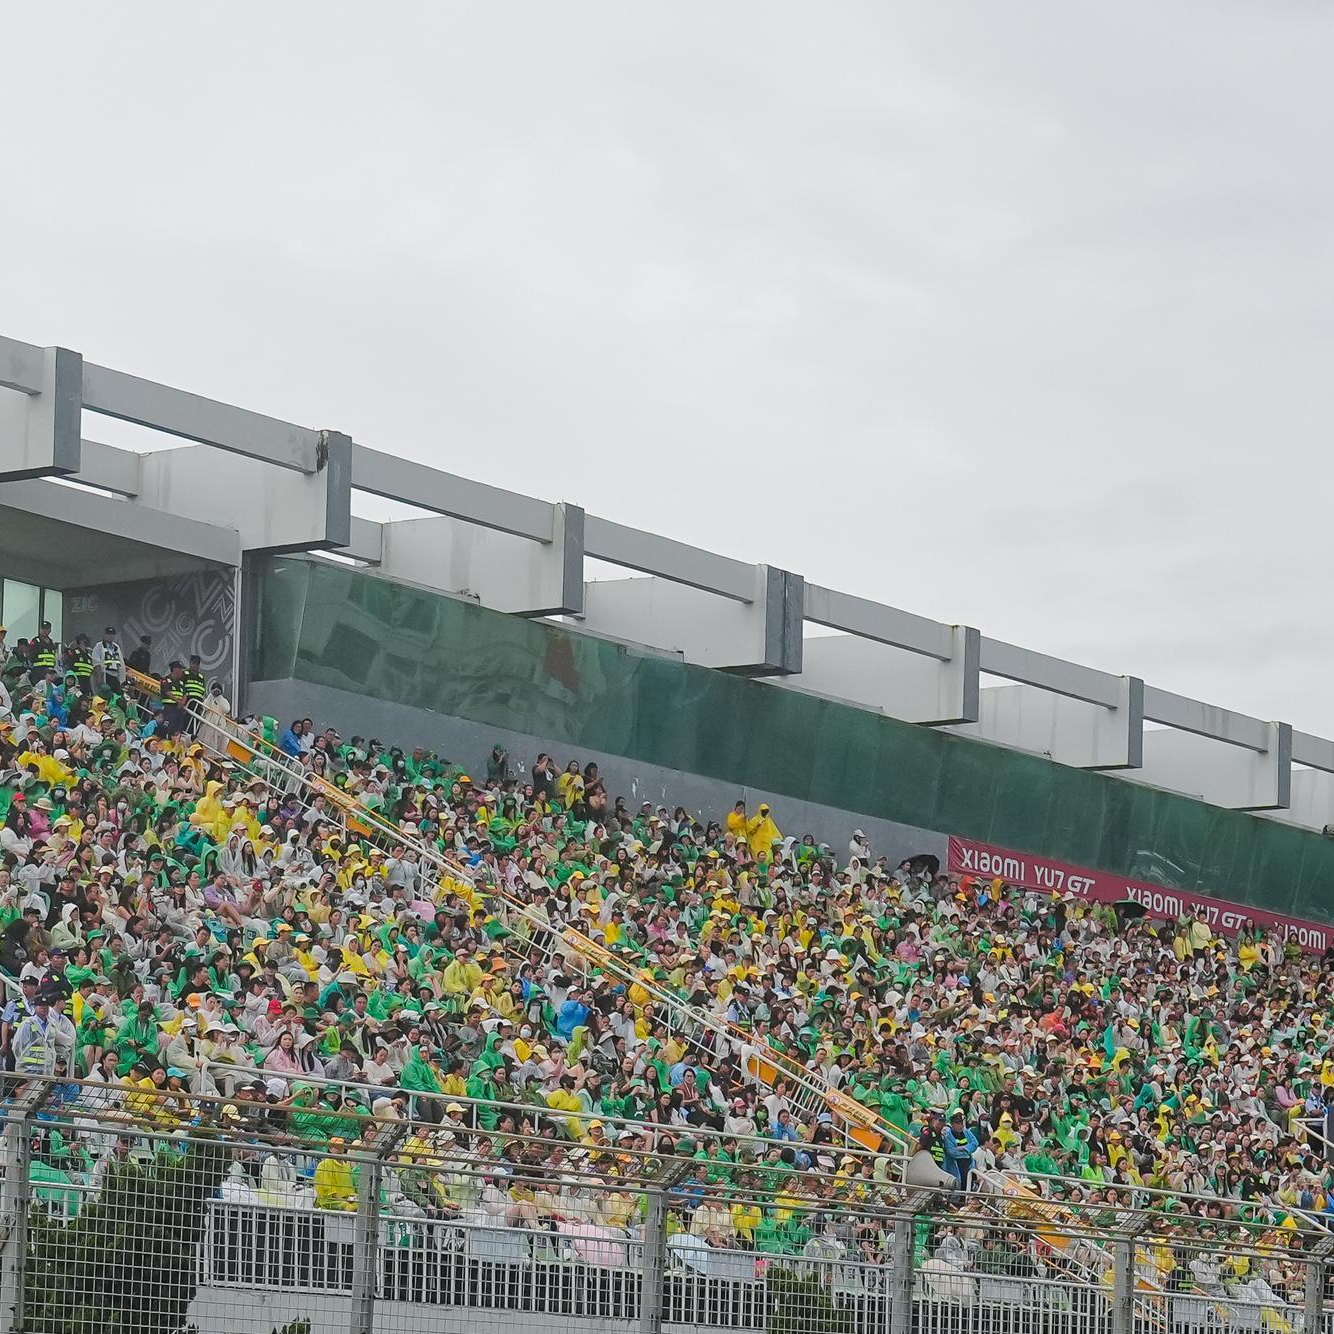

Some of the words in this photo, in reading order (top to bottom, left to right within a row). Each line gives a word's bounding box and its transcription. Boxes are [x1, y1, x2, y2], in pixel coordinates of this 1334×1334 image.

[1035, 865, 1065, 891] YU7
[1067, 875, 1096, 894] GT
[1221, 911, 1247, 930] GT
